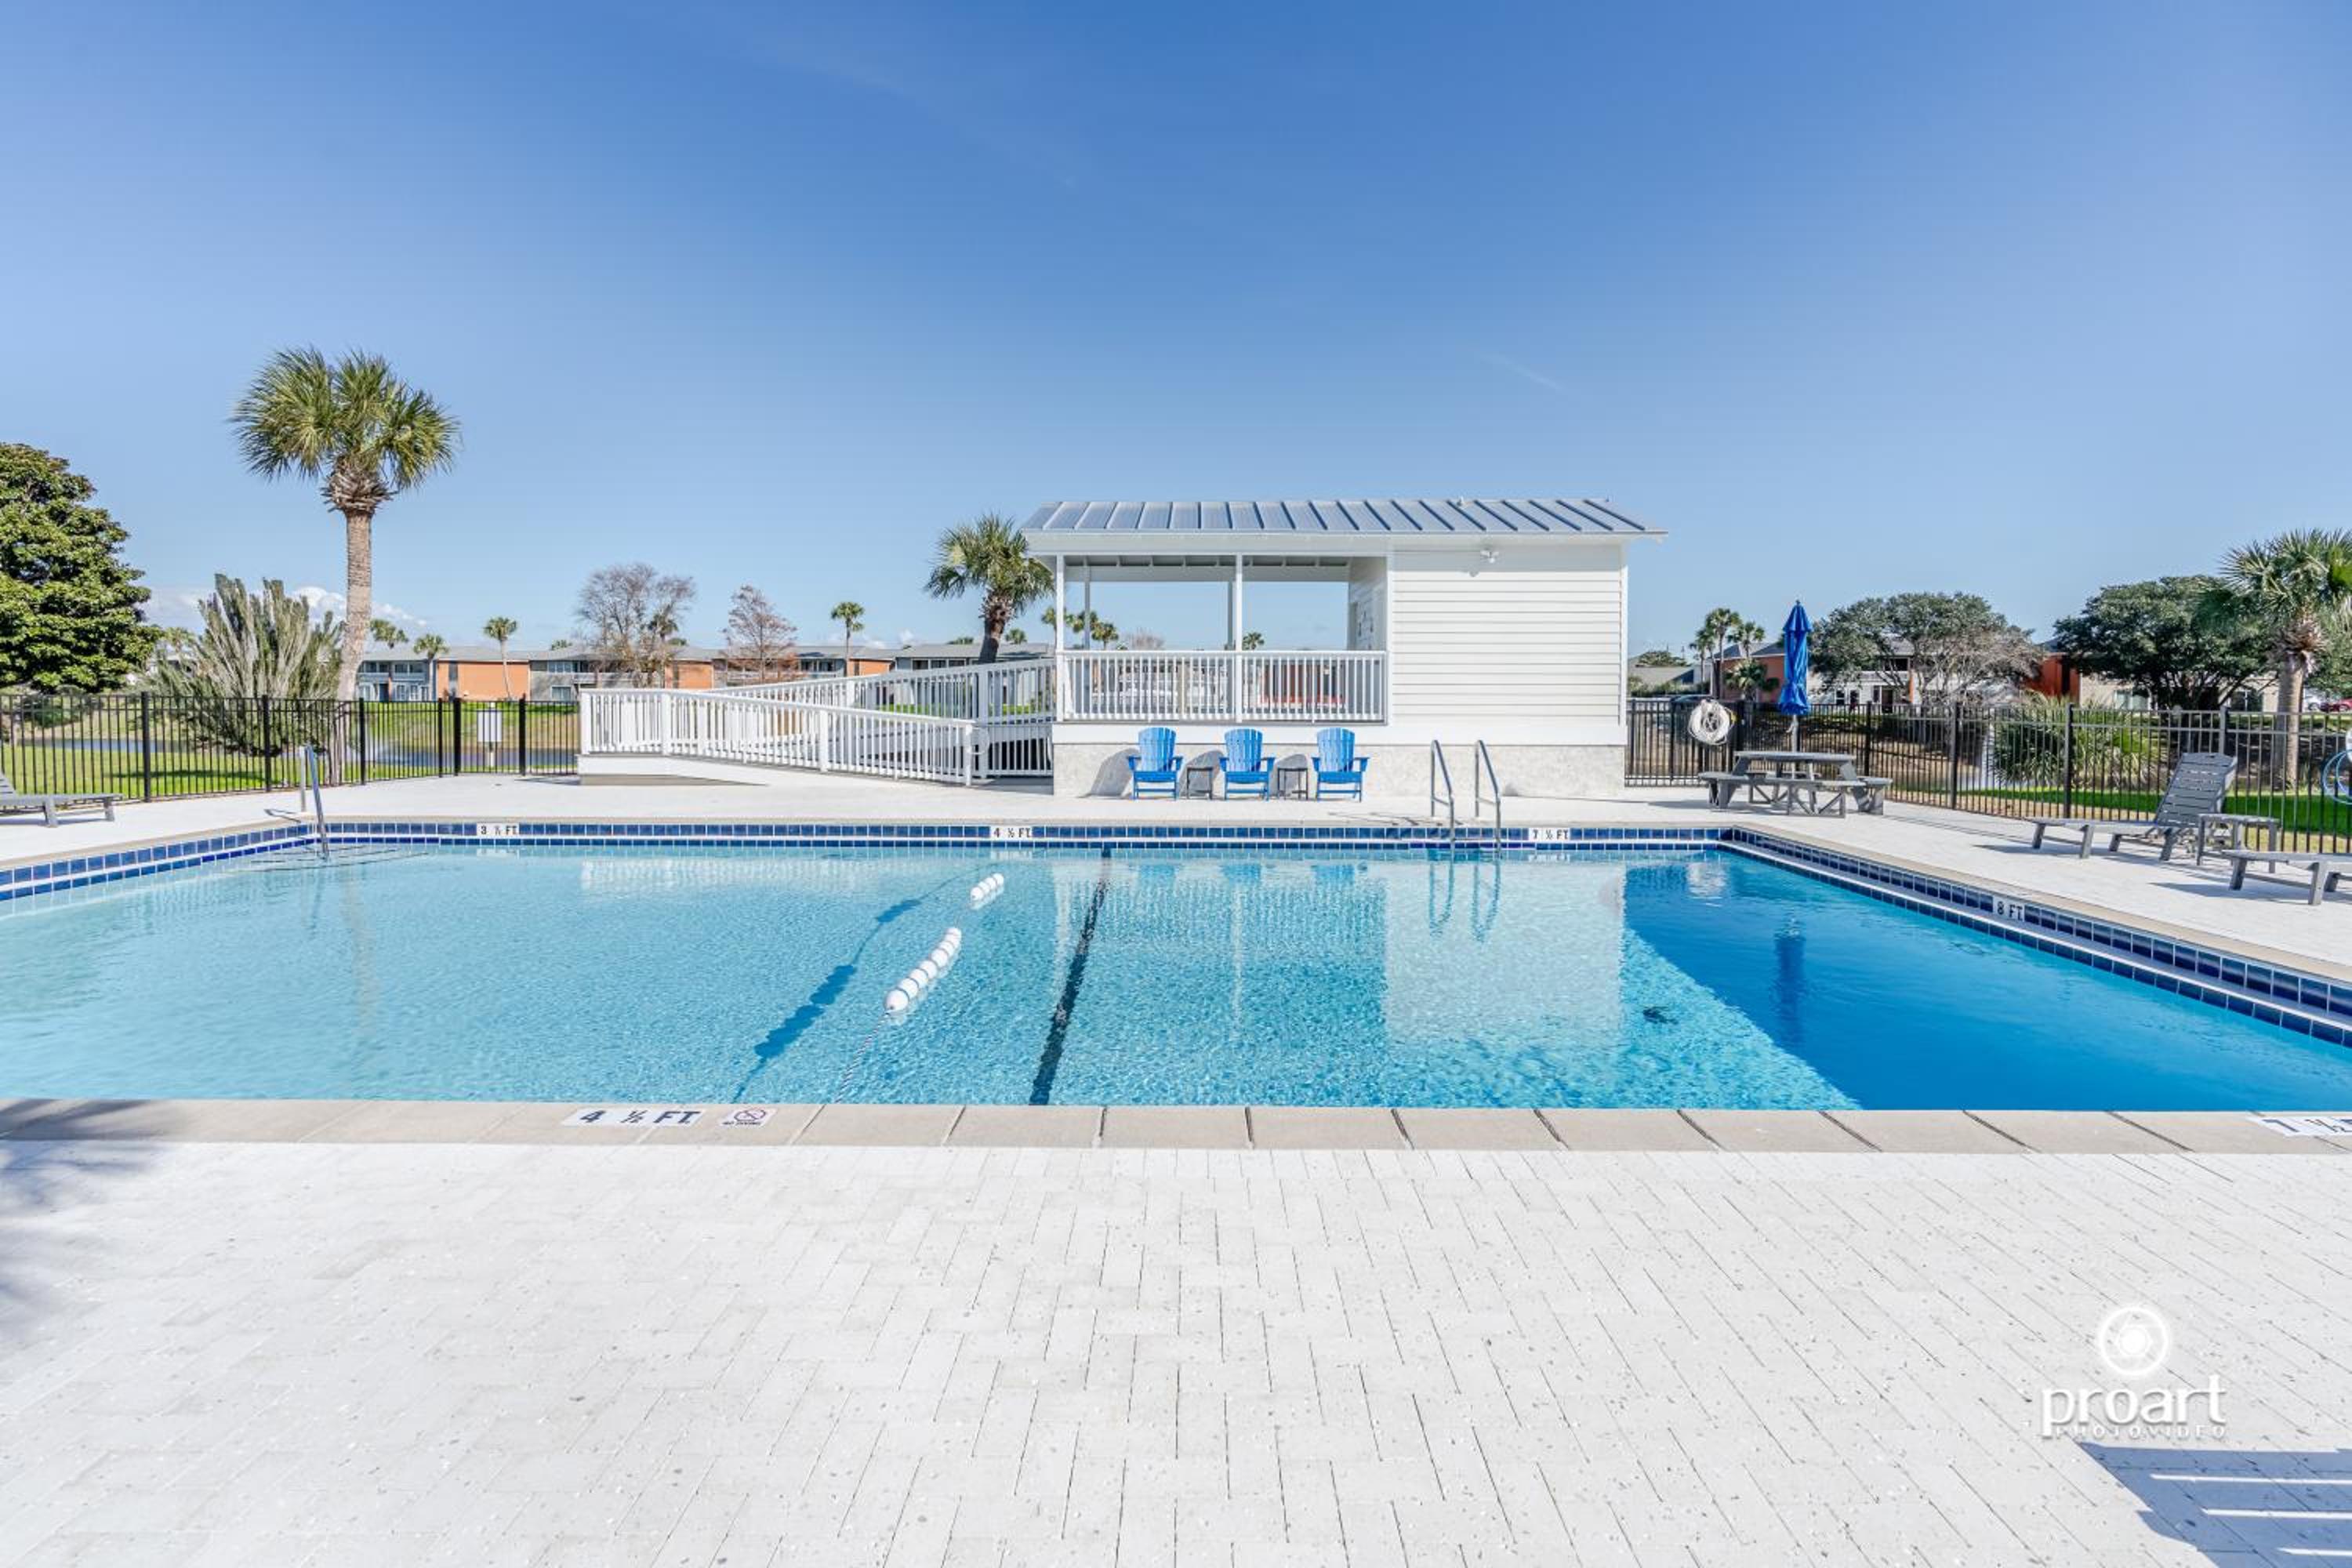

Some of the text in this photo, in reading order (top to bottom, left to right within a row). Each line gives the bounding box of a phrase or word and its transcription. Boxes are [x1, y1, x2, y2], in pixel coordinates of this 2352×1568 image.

[481, 825, 487, 835] 3
[993, 827, 1000, 838] 4
[1997, 901, 2005, 915] 8
[580, 1109, 606, 1123] 4
